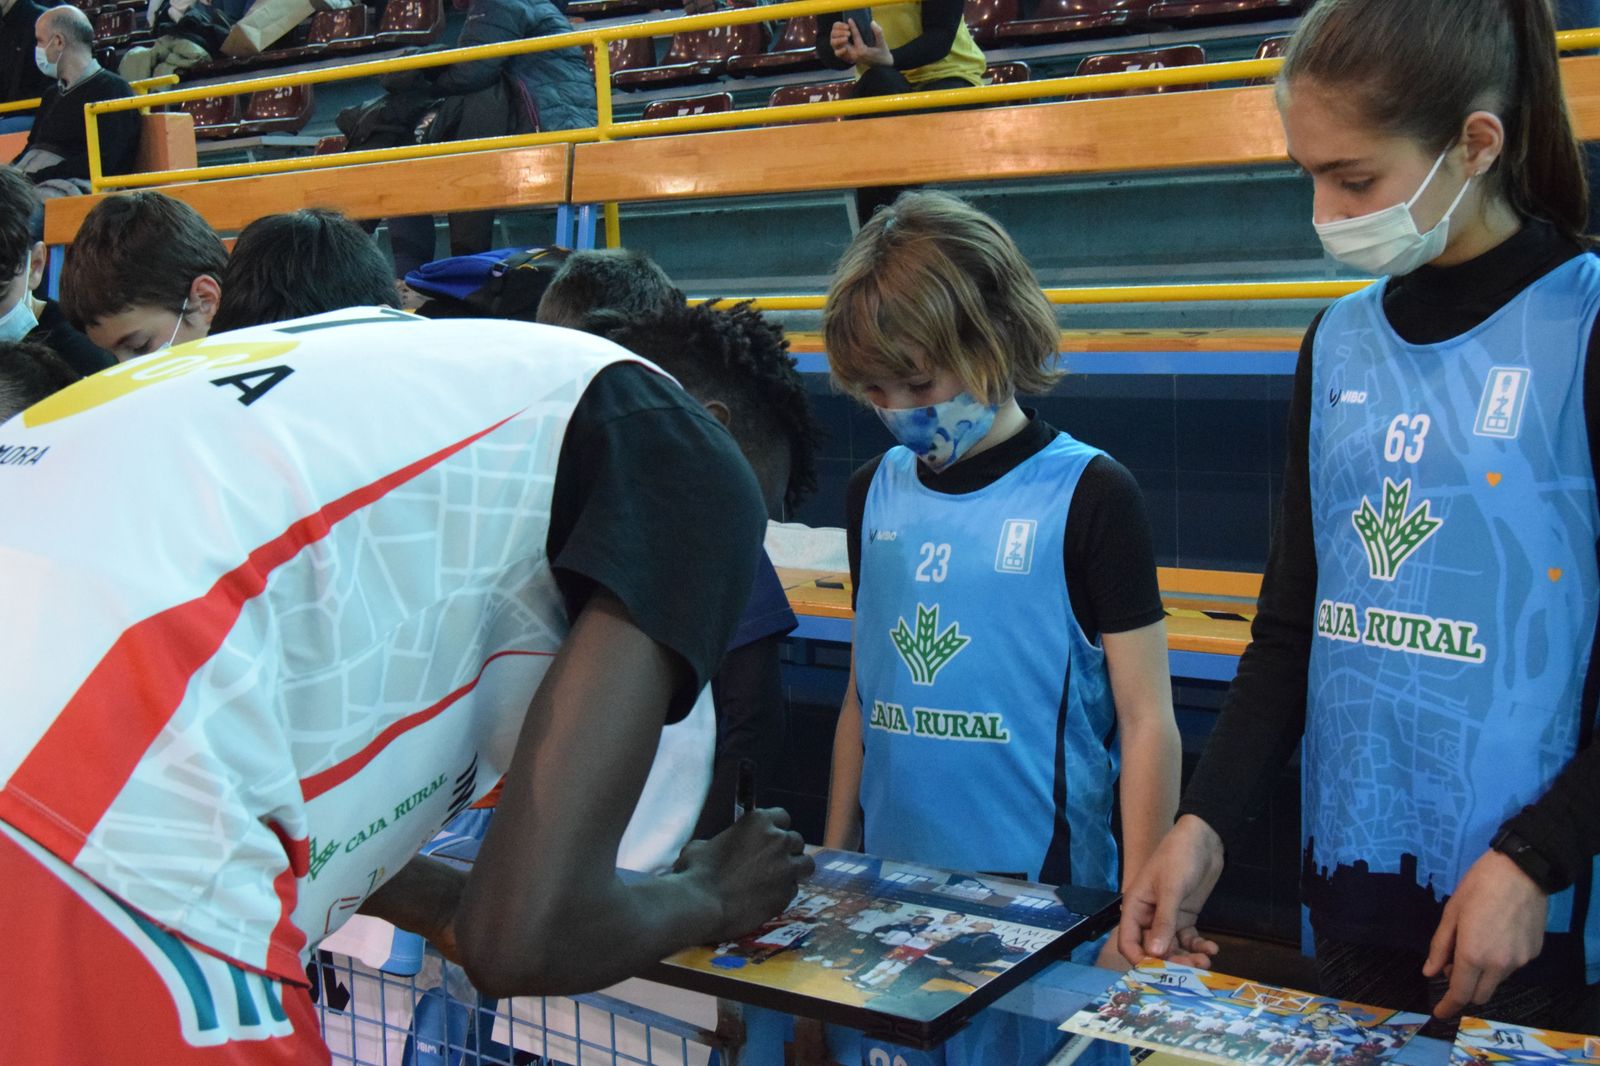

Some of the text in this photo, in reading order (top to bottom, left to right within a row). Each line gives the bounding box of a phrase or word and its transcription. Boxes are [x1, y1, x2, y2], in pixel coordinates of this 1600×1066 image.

[1383, 413, 1431, 464] 63
[915, 541, 952, 583] 23
[1317, 602, 1484, 661] CAJA RURAL
[869, 702, 1008, 742] AJA RURAL
[344, 772, 448, 853] CAJA RURAL
